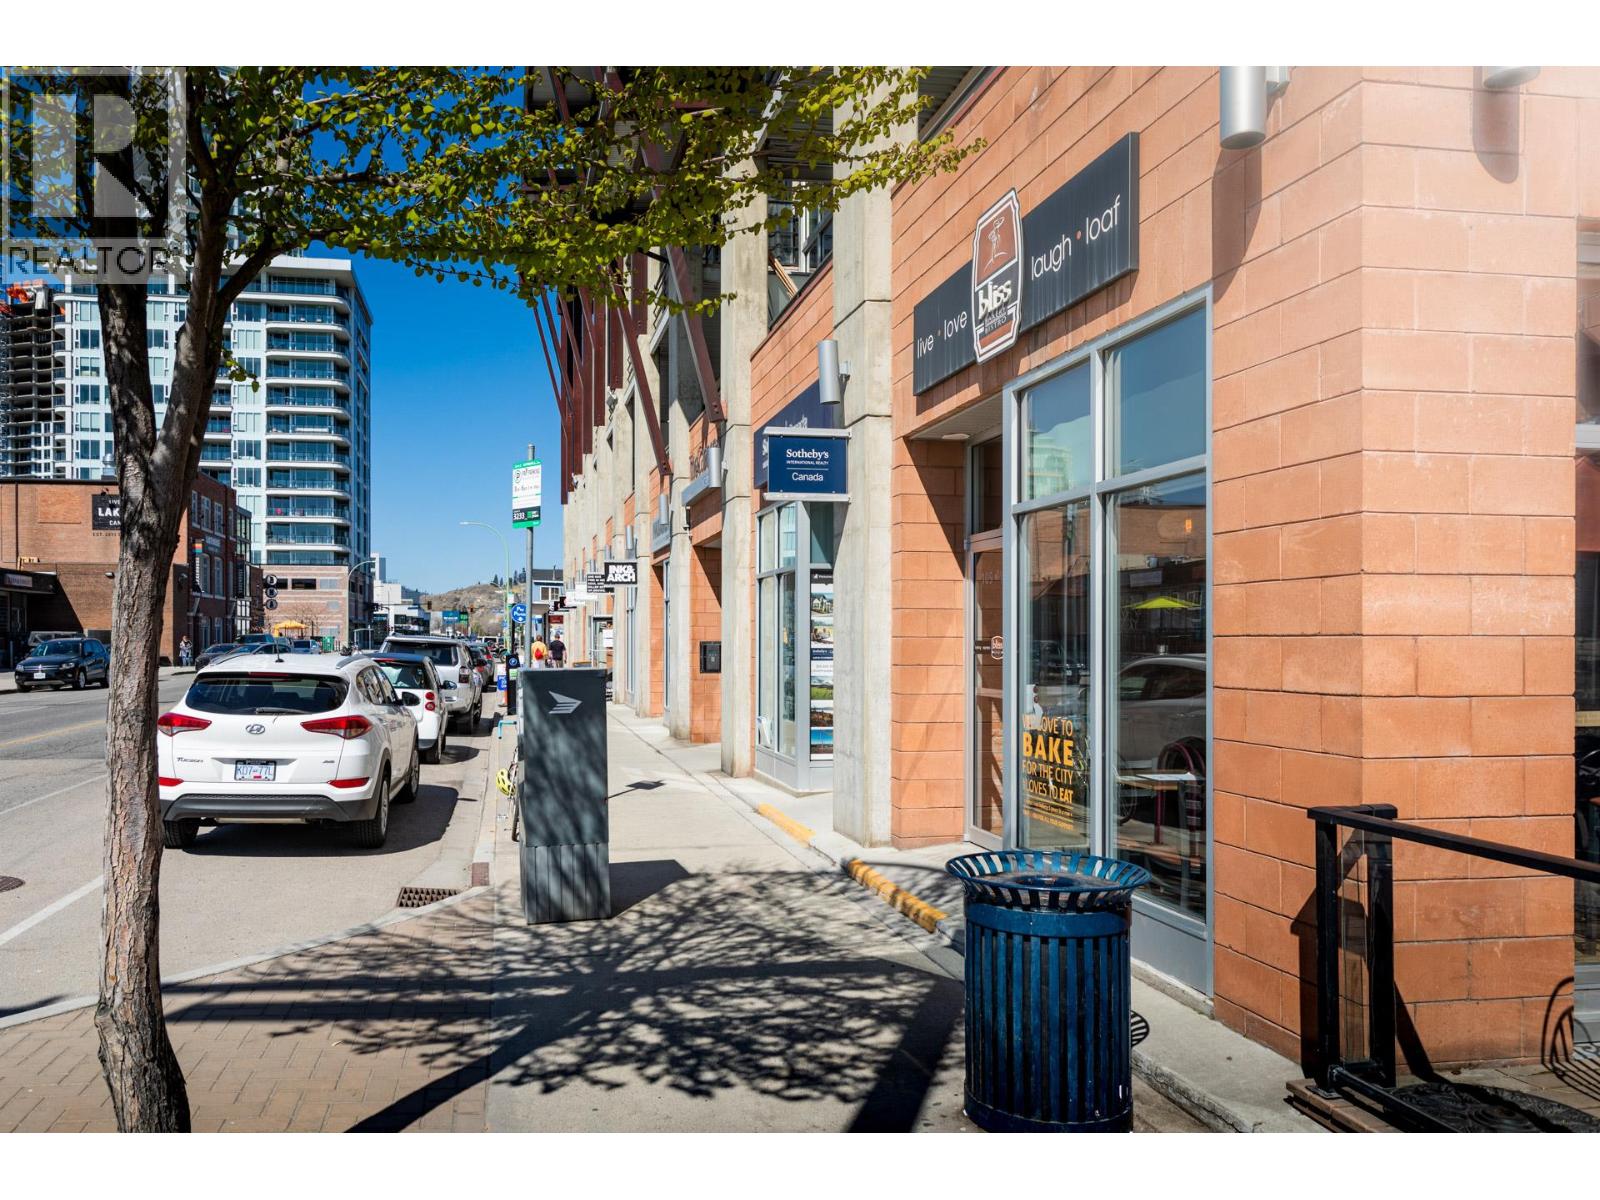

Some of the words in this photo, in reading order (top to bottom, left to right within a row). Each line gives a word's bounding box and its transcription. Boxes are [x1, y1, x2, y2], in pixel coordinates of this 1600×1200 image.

[1031, 233, 1072, 281] laugh
[1085, 193, 1121, 246] loaf
[978, 280, 1012, 320] bliss
[917, 334, 934, 359] live
[944, 310, 968, 341] love
[786, 448, 829, 460] Sotheby's
[791, 472, 824, 482] Canada
[98, 507, 120, 517] LAK
[606, 572, 636, 582] ARCH
[608, 564, 636, 575] INK&
[1060, 719, 1073, 737] TO
[1022, 731, 1074, 768] BAKE
[1038, 763, 1054, 781] THE
[1055, 768, 1073, 785] CITY
[1059, 787, 1073, 804] EAT
